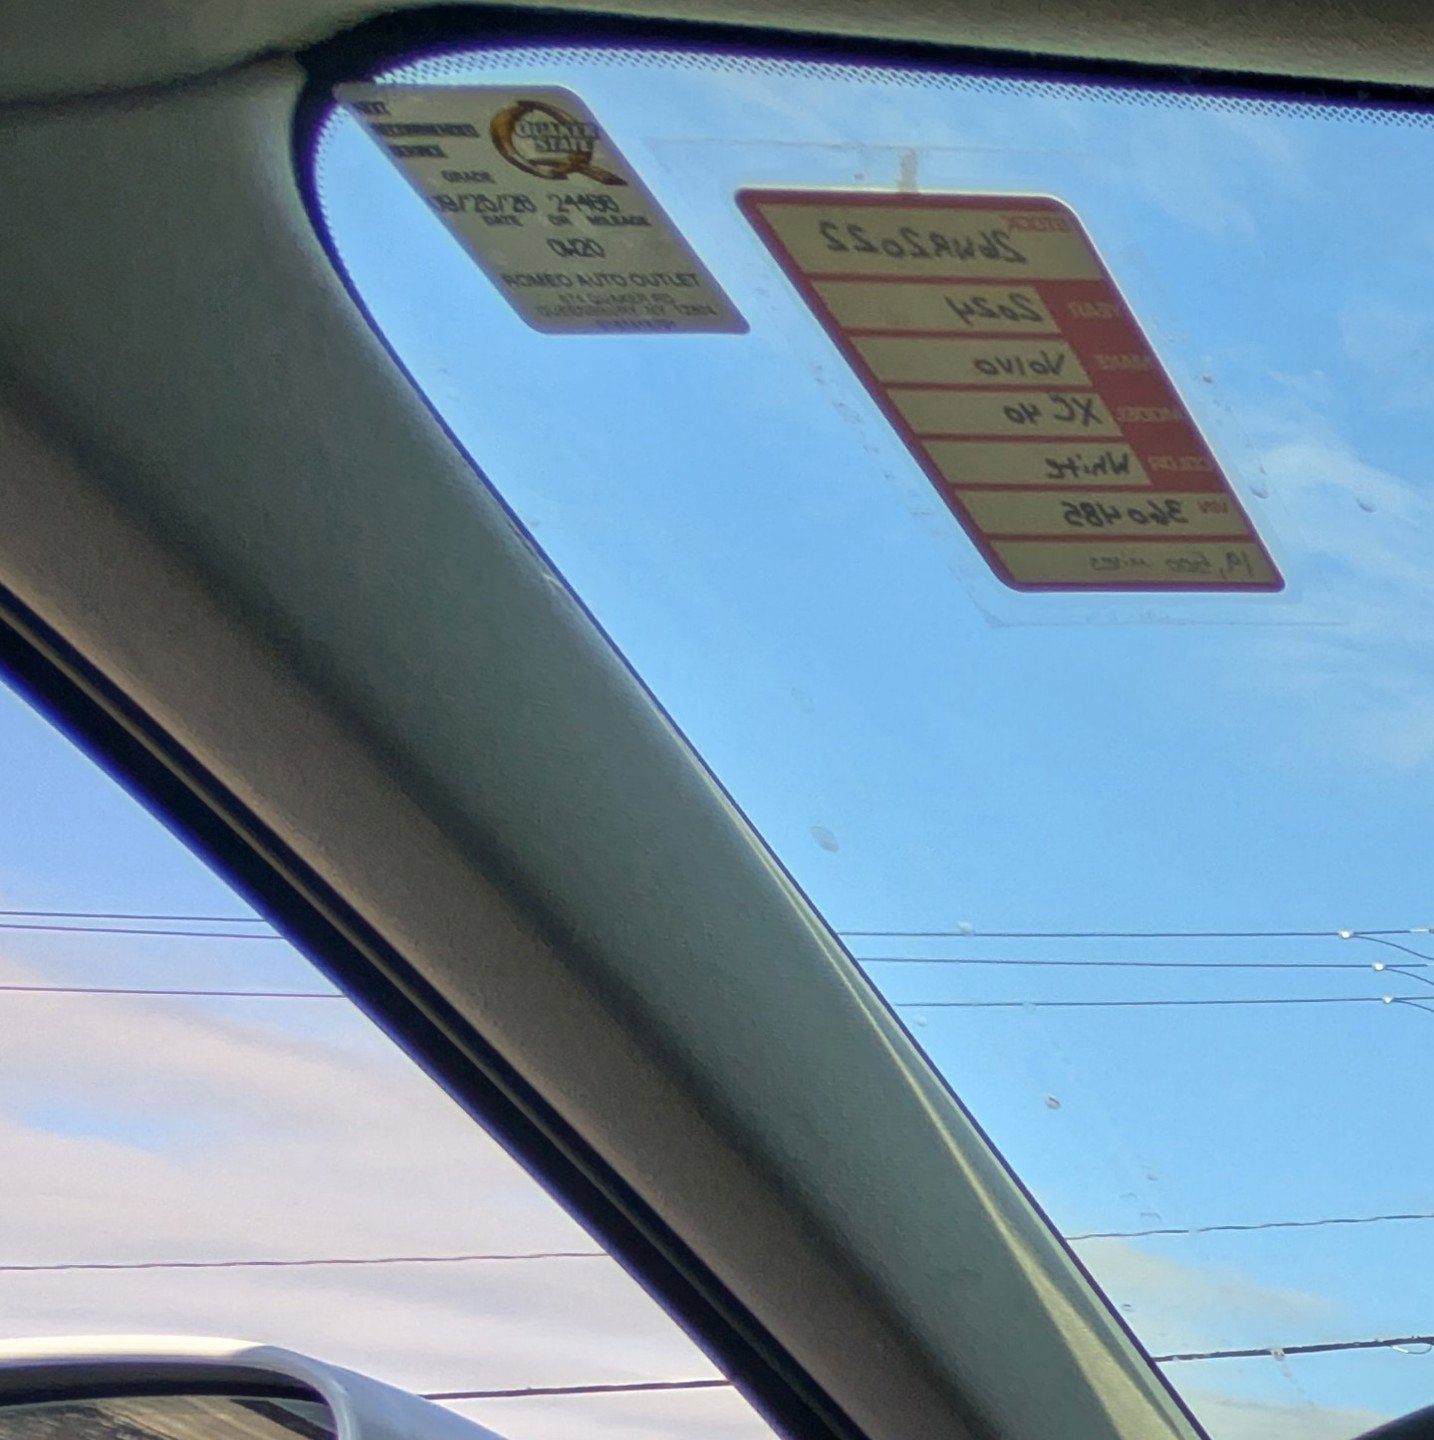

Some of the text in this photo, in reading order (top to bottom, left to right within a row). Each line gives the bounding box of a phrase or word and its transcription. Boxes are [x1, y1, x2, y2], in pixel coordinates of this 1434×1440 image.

[535, 137, 594, 152] STATE
[481, 214, 653, 228] DATE OR MILEAGE
[502, 272, 701, 287] ROMEO AUTO OUTLET
